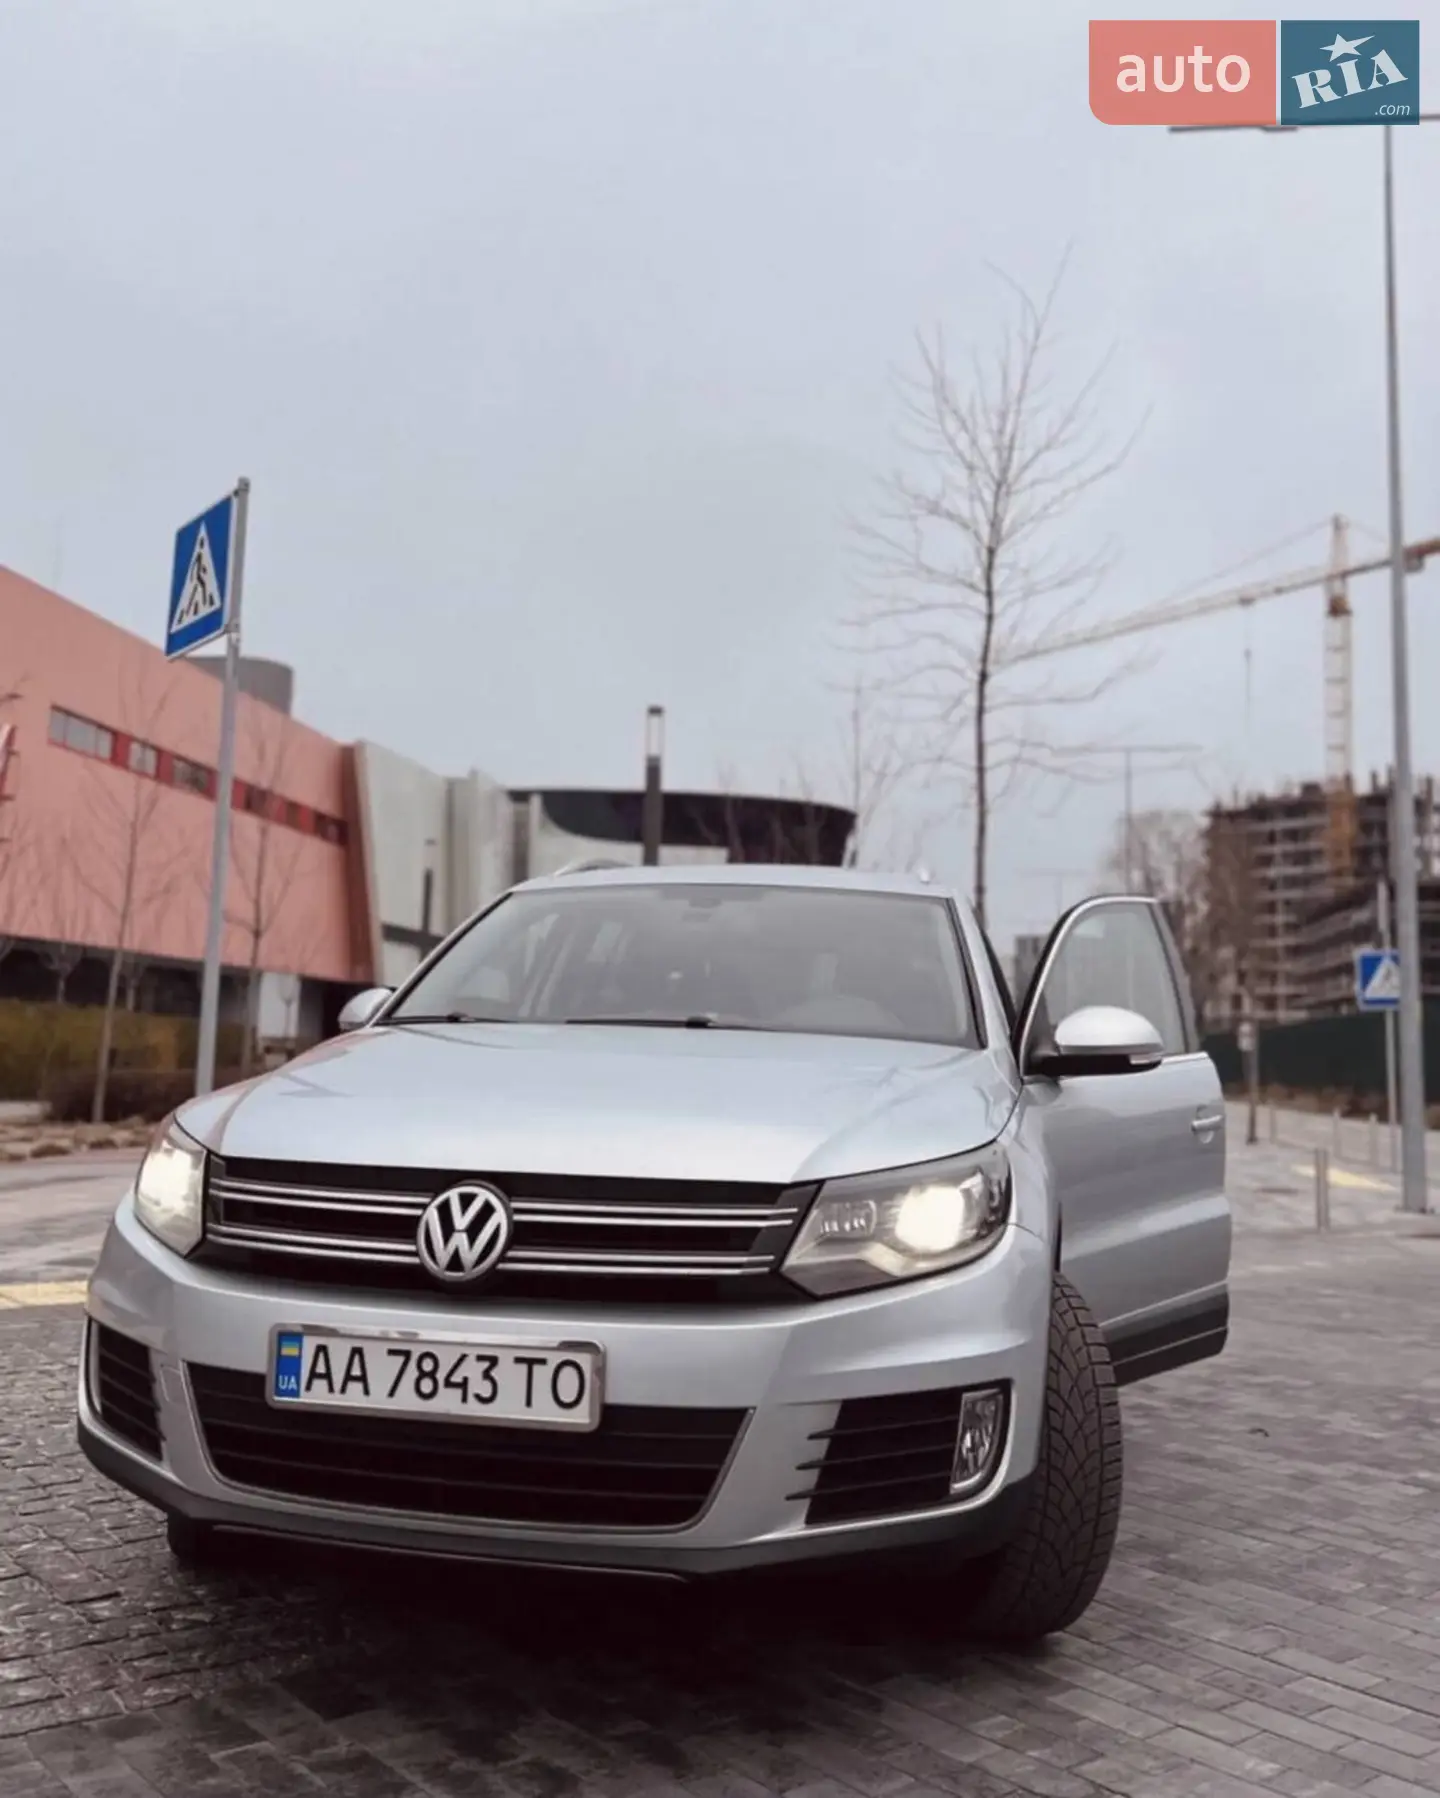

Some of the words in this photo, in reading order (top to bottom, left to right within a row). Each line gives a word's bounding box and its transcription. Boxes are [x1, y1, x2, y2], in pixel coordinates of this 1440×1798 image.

[278, 1374, 297, 1391] UA
[304, 1344, 370, 1397] AA
[387, 1349, 499, 1405] 7843
[513, 1356, 586, 1410] TO
